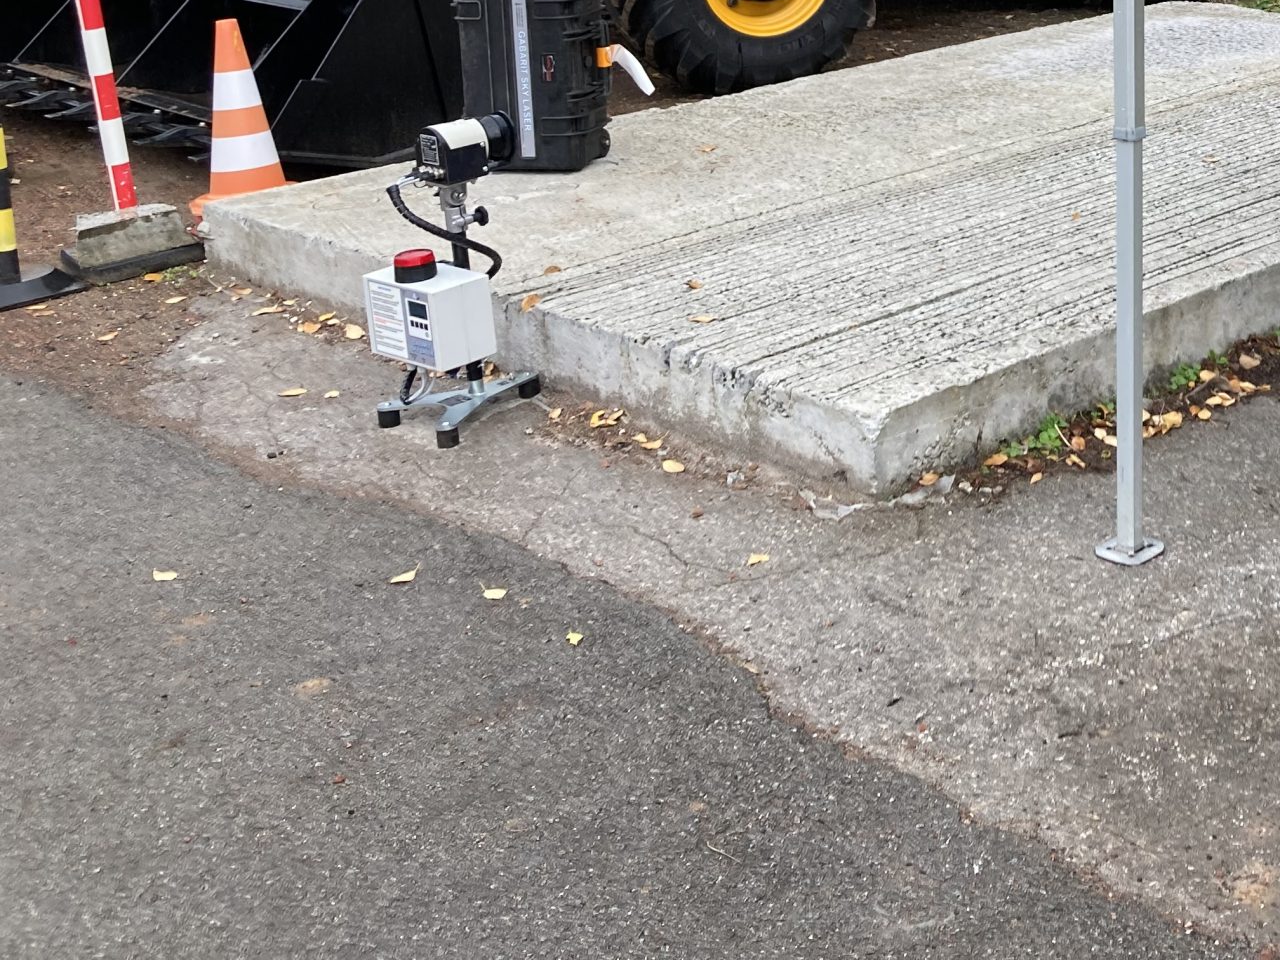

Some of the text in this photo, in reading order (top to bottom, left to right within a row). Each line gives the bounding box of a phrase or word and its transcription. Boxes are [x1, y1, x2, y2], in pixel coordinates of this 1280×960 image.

[517, 31, 529, 75] GABARIT
[520, 76, 530, 97] SKY
[522, 99, 532, 131] LASER
